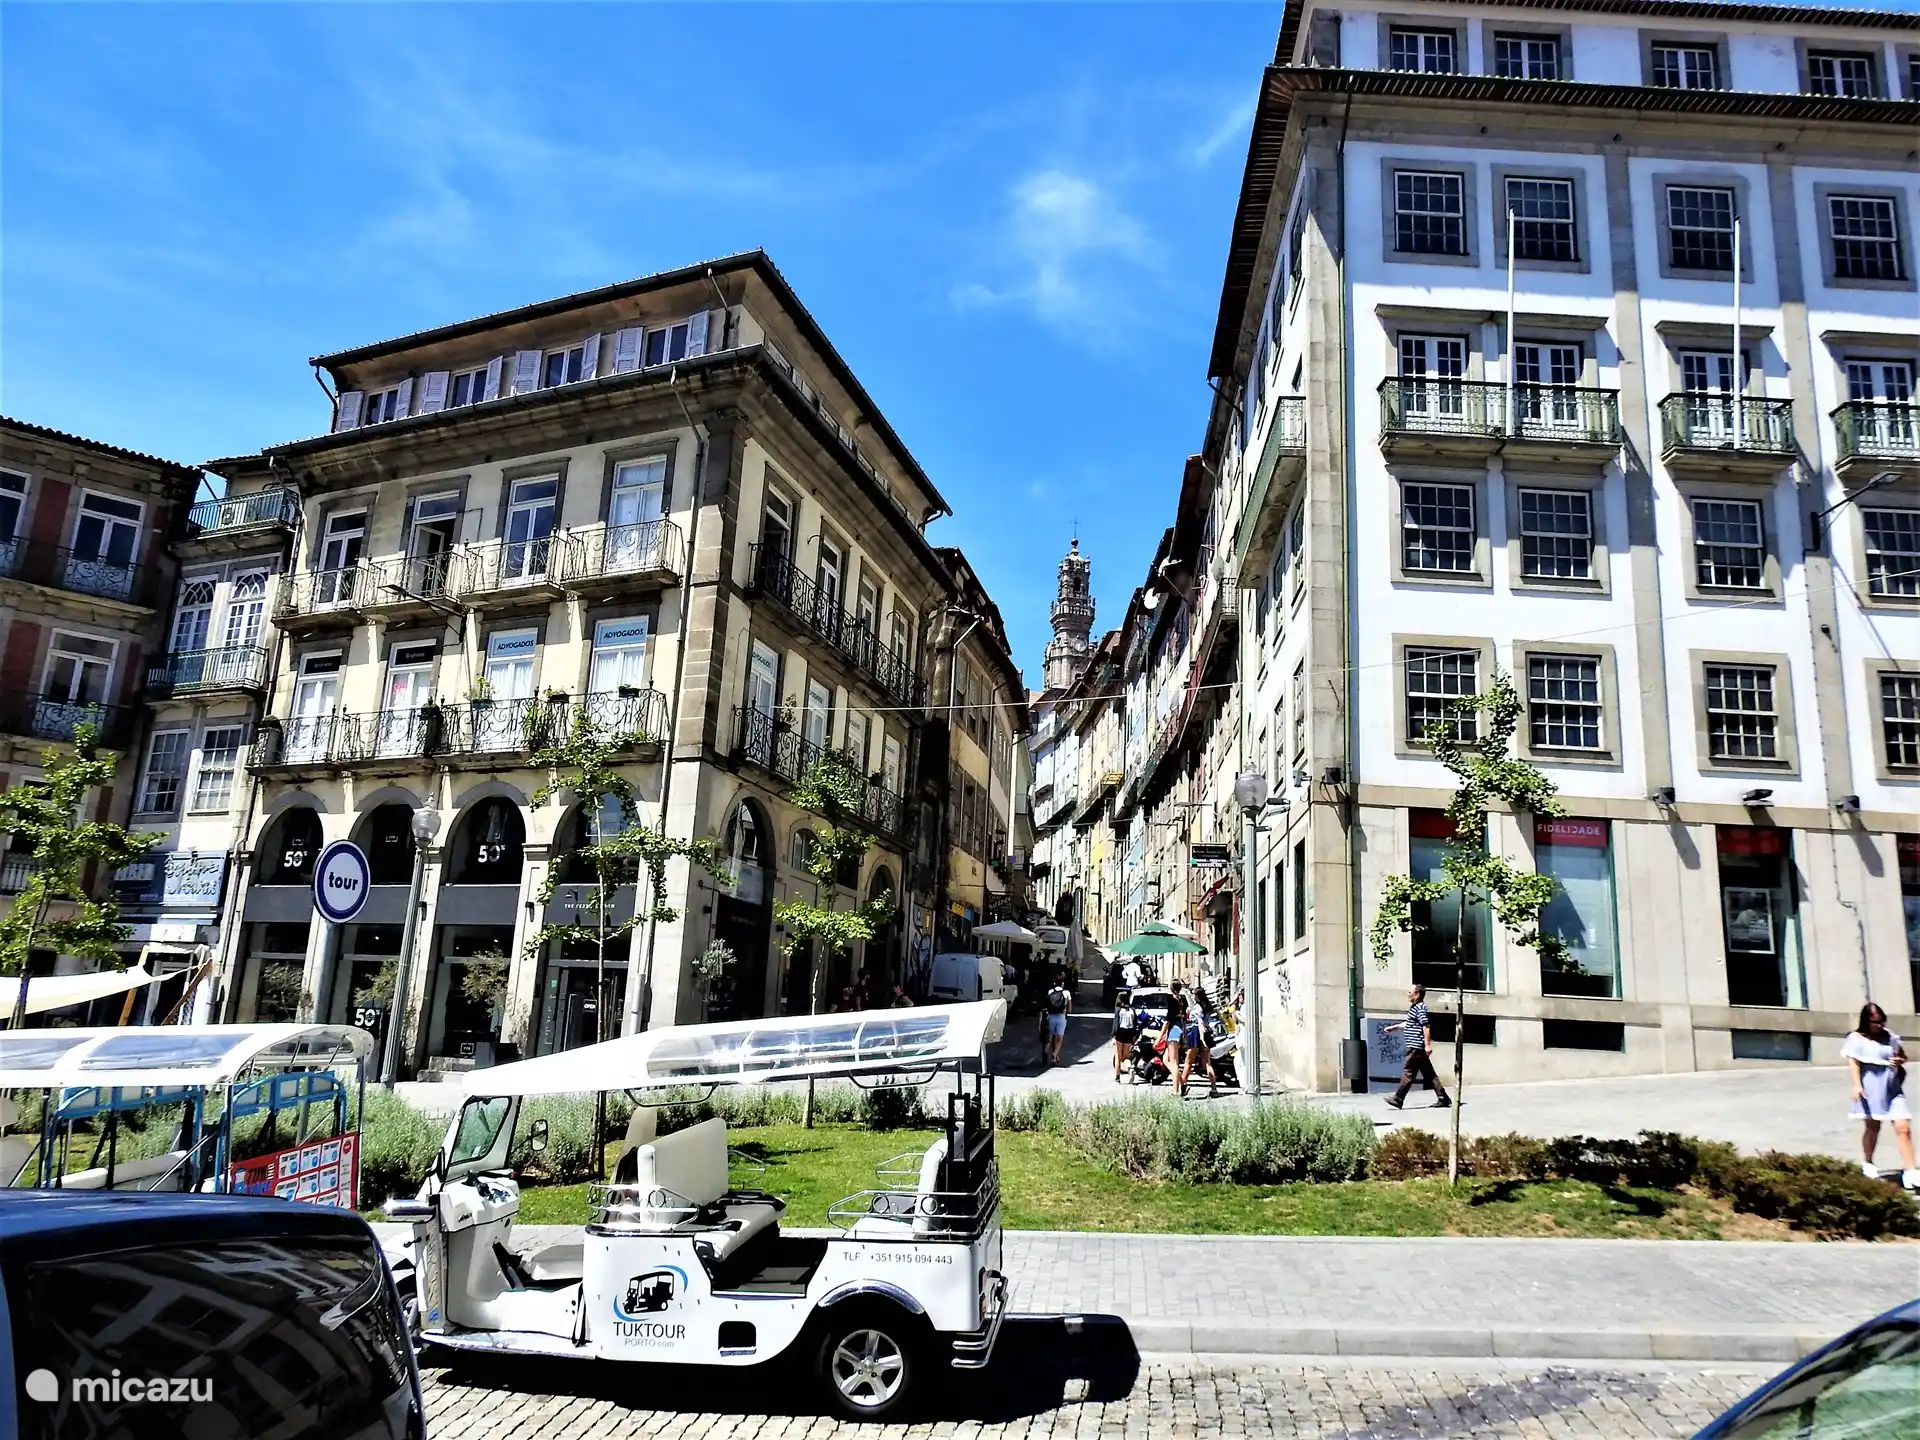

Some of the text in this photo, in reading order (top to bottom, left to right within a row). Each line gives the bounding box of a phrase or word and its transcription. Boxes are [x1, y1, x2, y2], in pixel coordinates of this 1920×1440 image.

[603, 628, 644, 639] ADVOGADOS
[497, 639, 534, 650] ADVOGADOS
[1537, 824, 1601, 836] FIDELIDADE
[328, 872, 359, 891] tour
[895, 1254, 913, 1263] 915
[915, 1255, 932, 1264] 094
[935, 1256, 953, 1264] 443
[613, 1321, 686, 1339] TUKTOUR
[624, 1338, 656, 1348] PORTO
